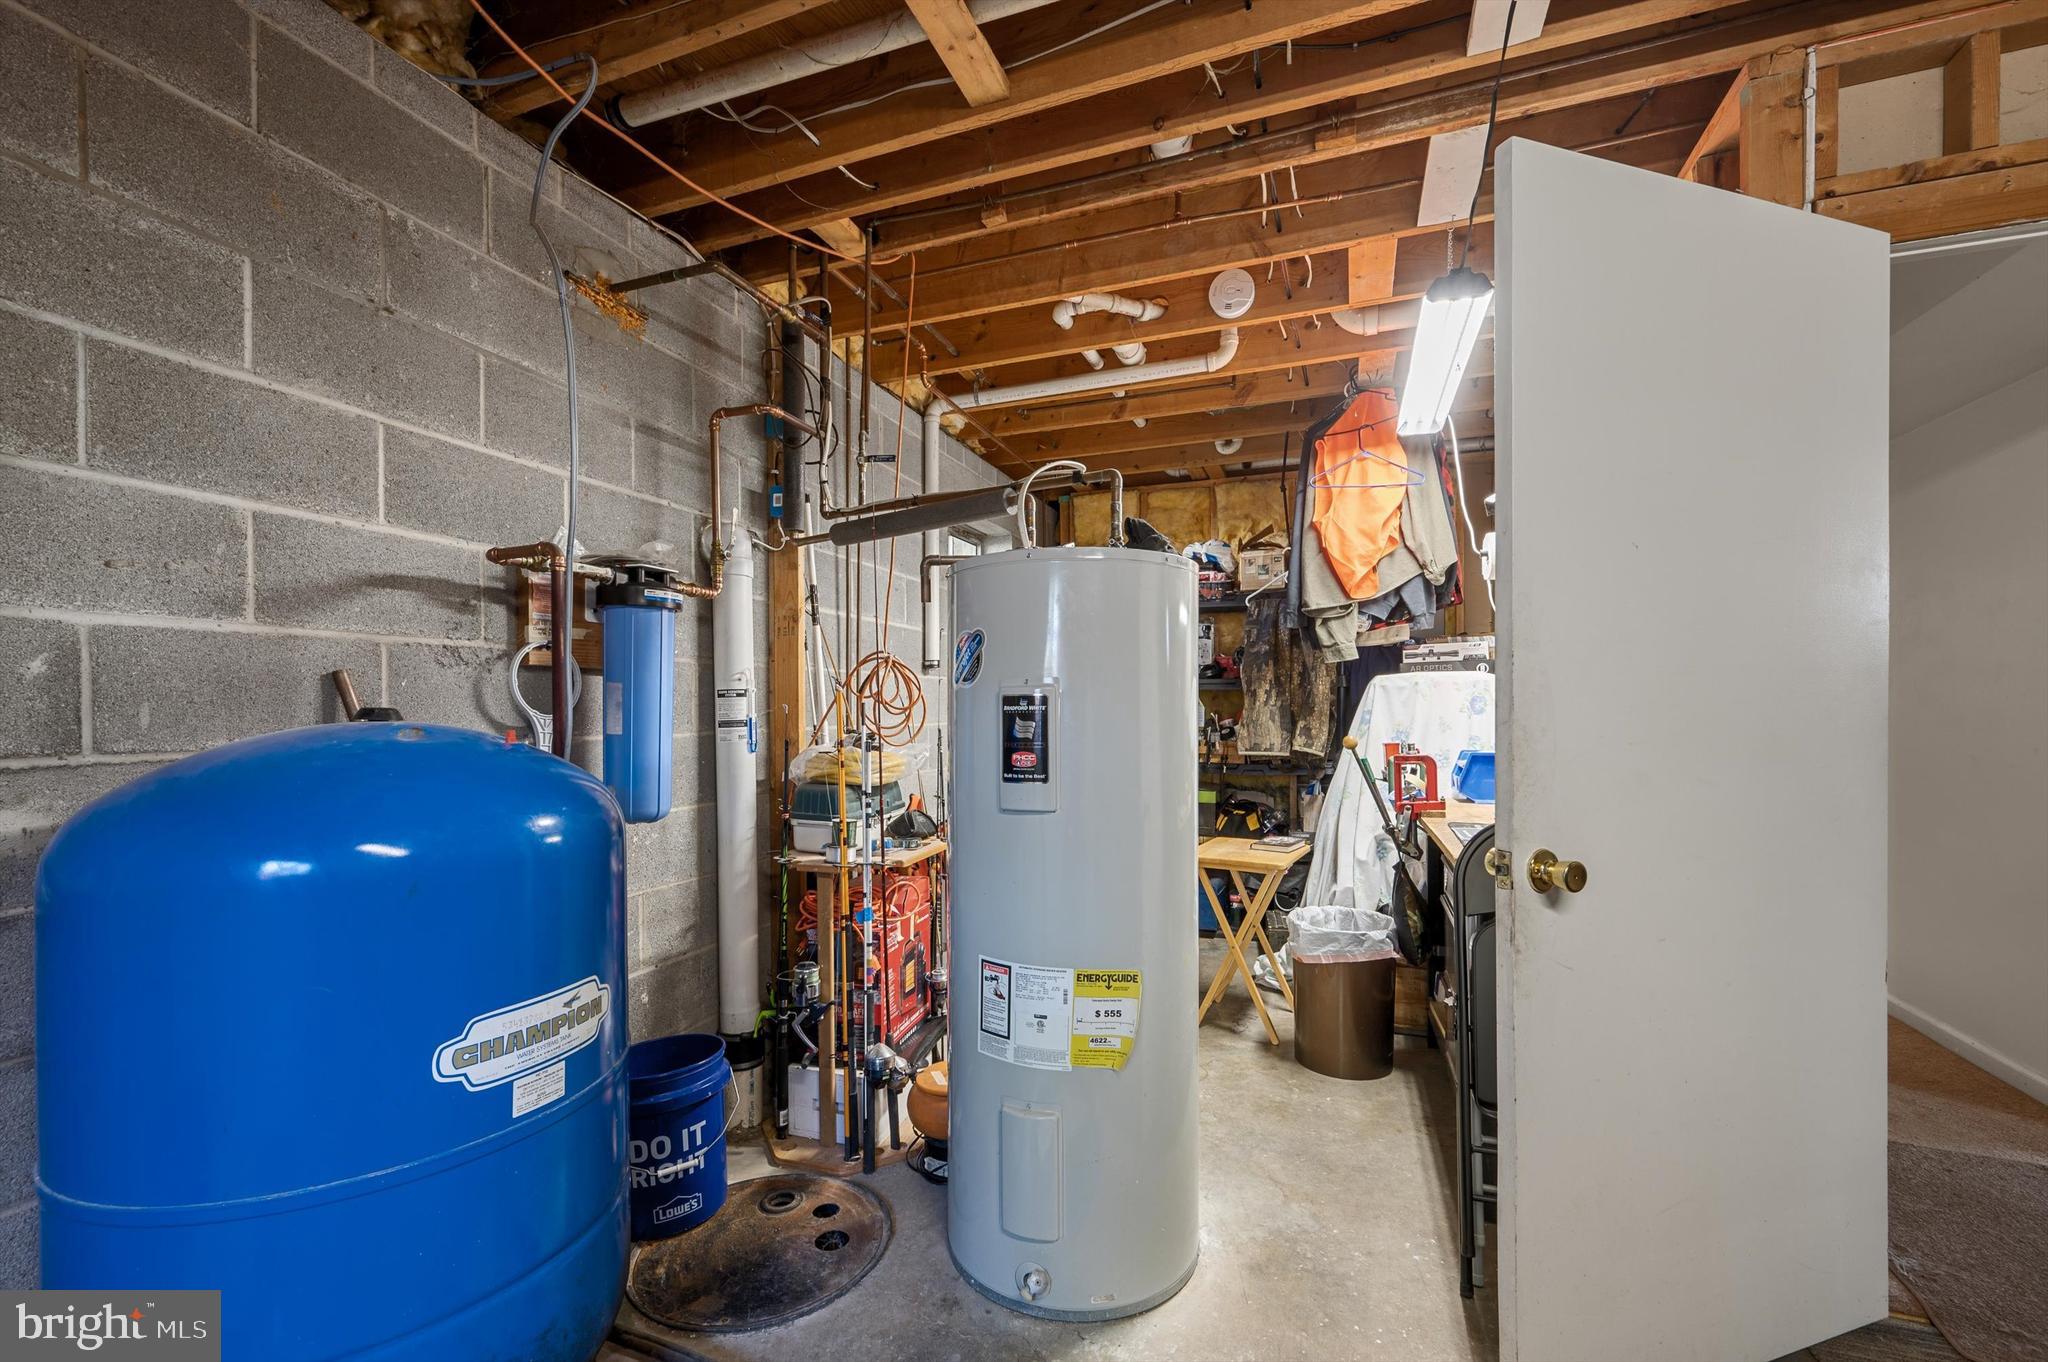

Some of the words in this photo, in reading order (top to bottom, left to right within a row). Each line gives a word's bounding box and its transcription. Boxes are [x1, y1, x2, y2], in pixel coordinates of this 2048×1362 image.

[1076, 973, 1139, 986] ENERGYGUIDE
[1104, 1009, 1122, 1018] 555
[452, 995, 603, 1070] CHAMPION
[630, 1135, 671, 1164] DO
[682, 1119, 707, 1152] IT
[631, 1146, 708, 1189] RIGHT
[659, 1199, 698, 1220] LOWE'S
